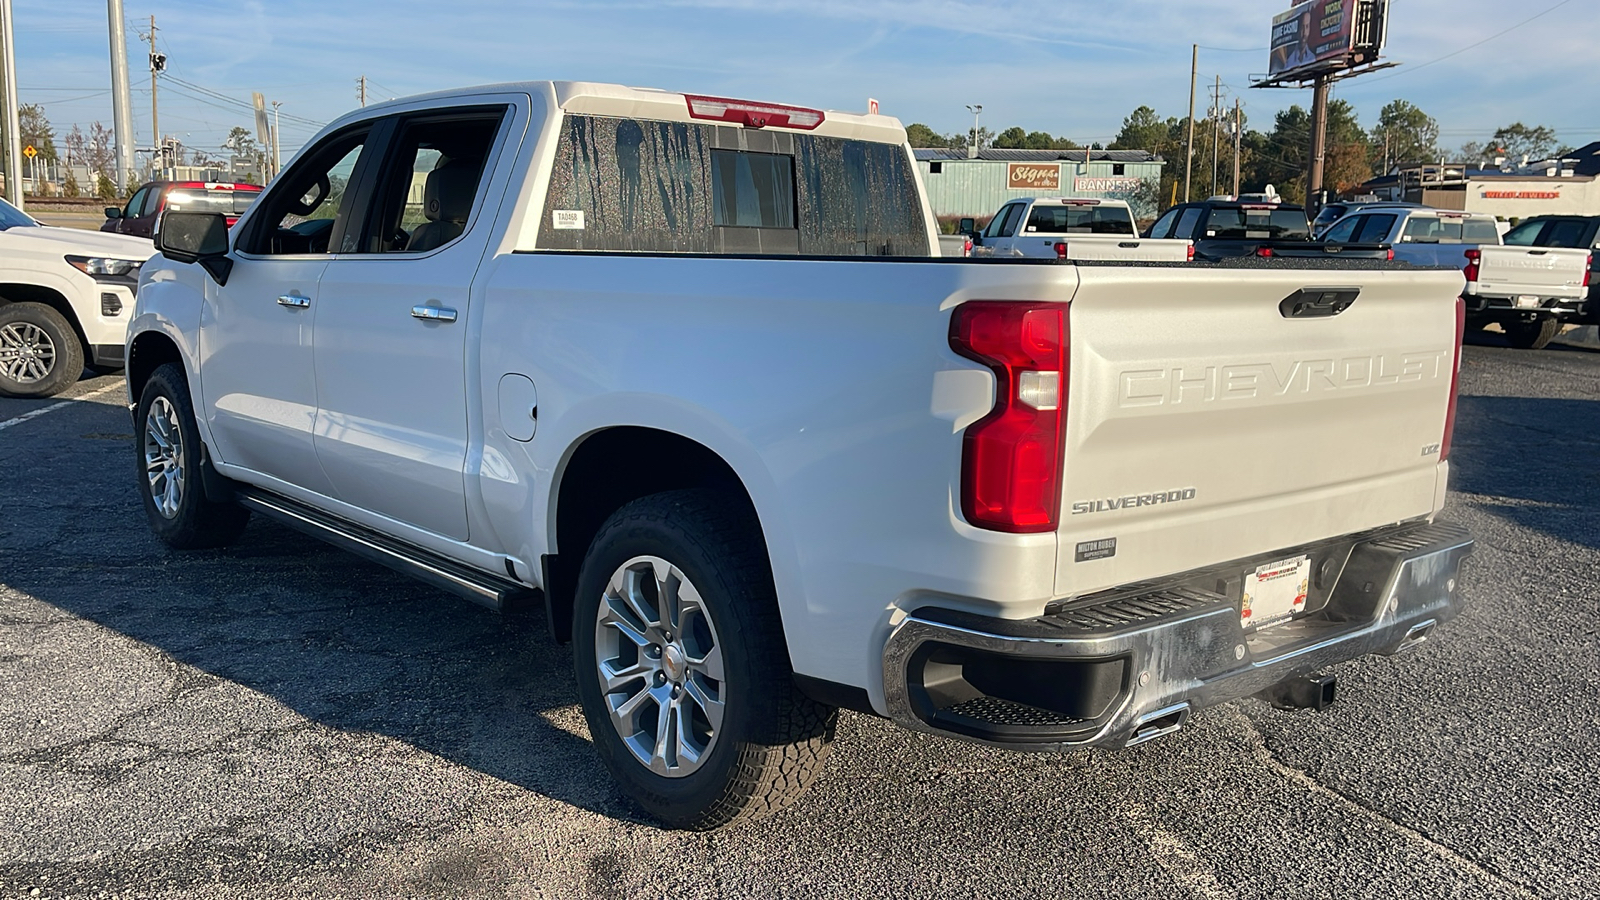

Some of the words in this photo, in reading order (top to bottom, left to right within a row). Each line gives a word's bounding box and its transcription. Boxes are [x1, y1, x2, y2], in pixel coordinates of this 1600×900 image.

[1011, 166, 1055, 183] Signs
[1117, 350, 1447, 409] CHEVROLET
[1072, 487, 1197, 515] SILVERADO
[1078, 541, 1098, 553] MILTON
[1098, 539, 1116, 550] RUBEN
[1279, 566, 1298, 574] RUBEN
